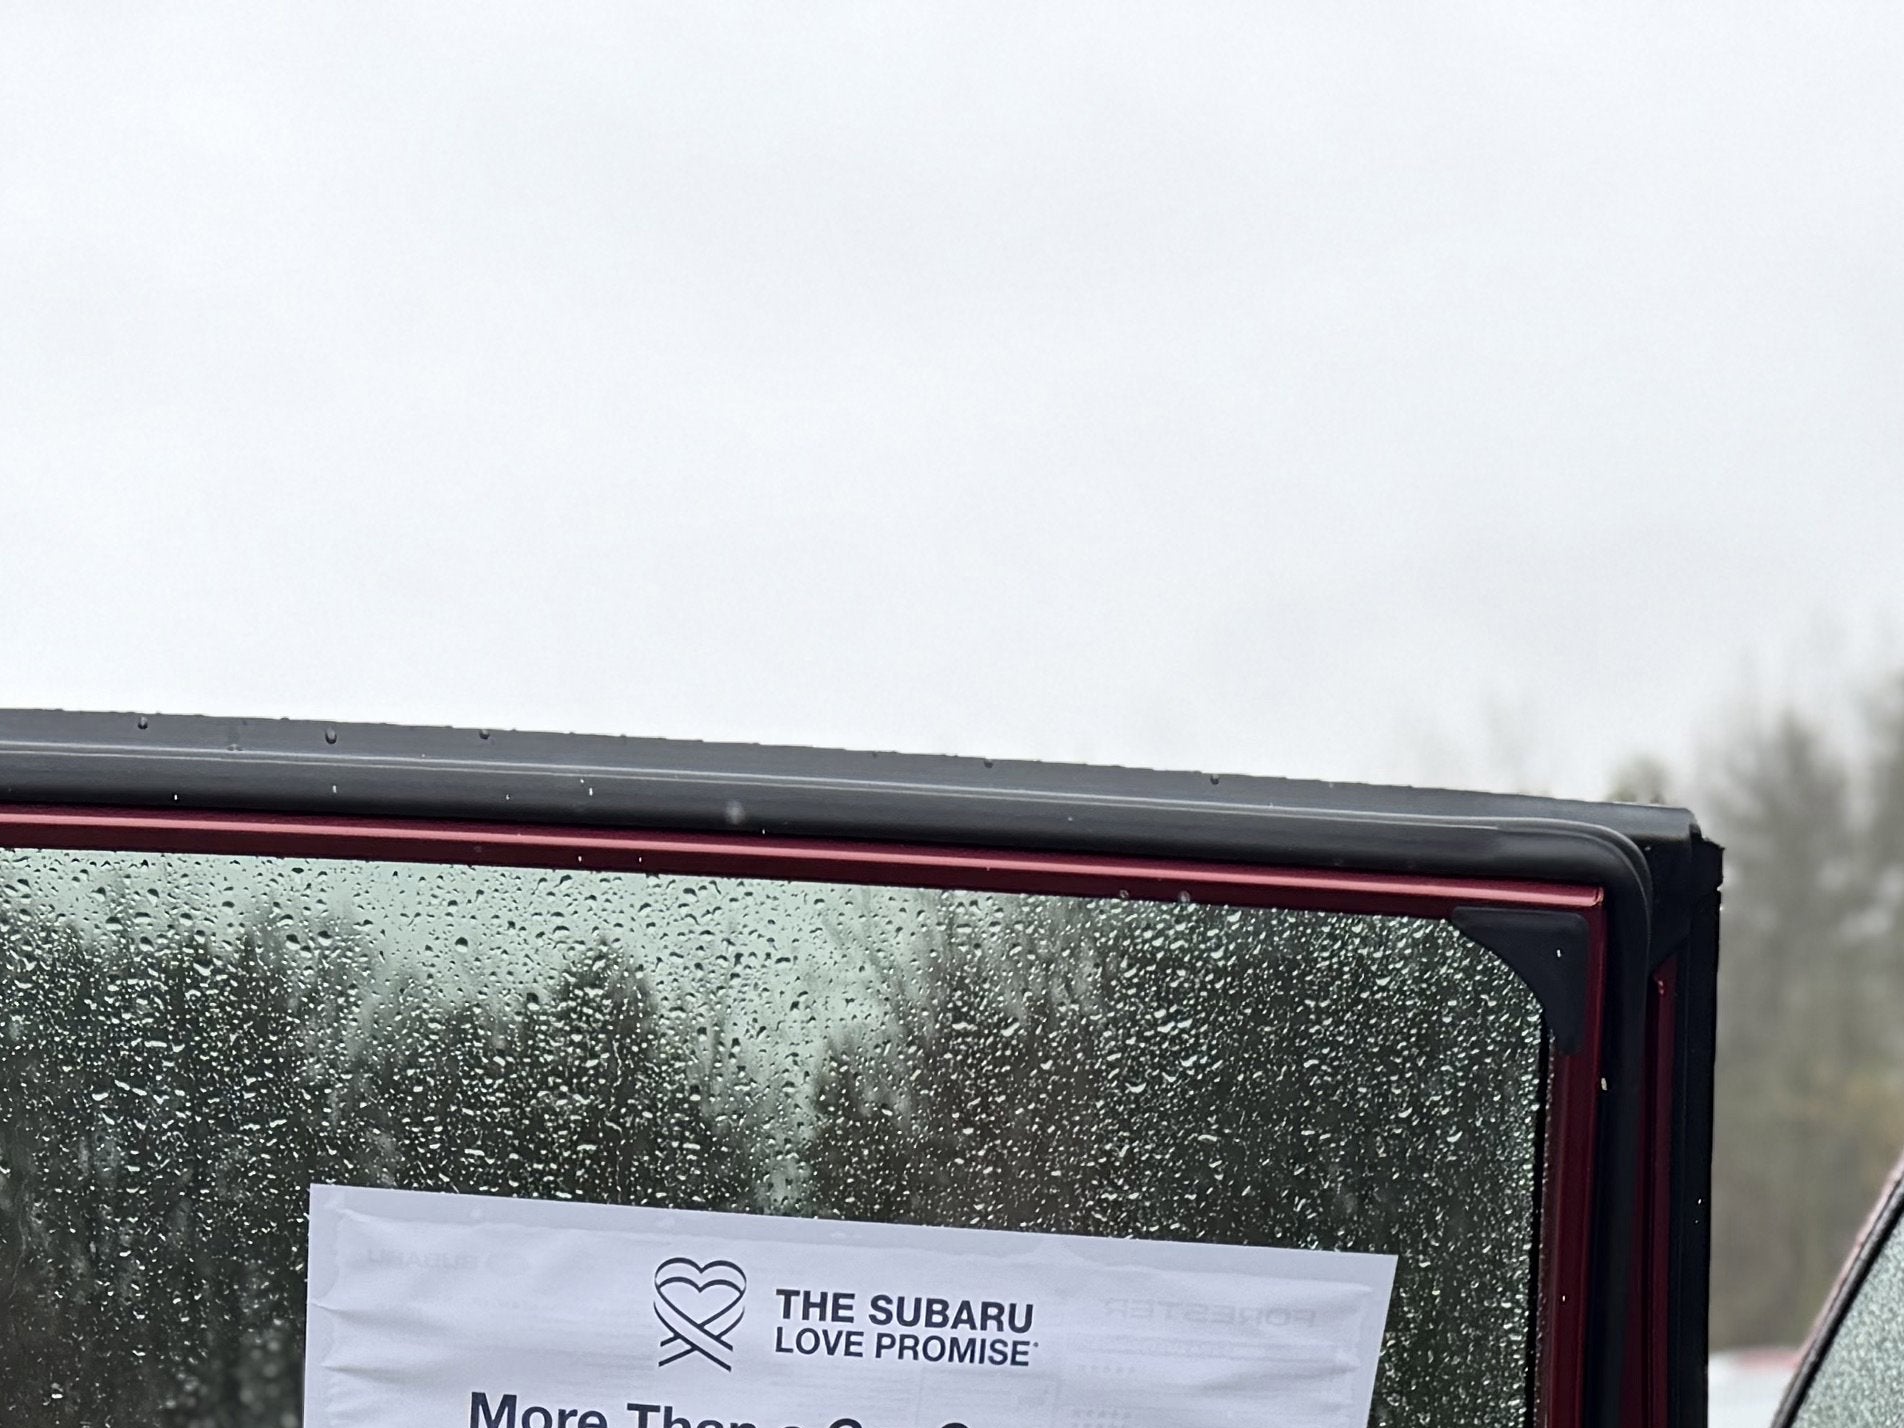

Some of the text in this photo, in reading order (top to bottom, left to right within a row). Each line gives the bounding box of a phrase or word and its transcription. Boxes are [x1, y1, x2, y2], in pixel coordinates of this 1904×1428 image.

[776, 1288, 1034, 1334] THE SUBARU
[775, 1326, 864, 1358] LOVE
